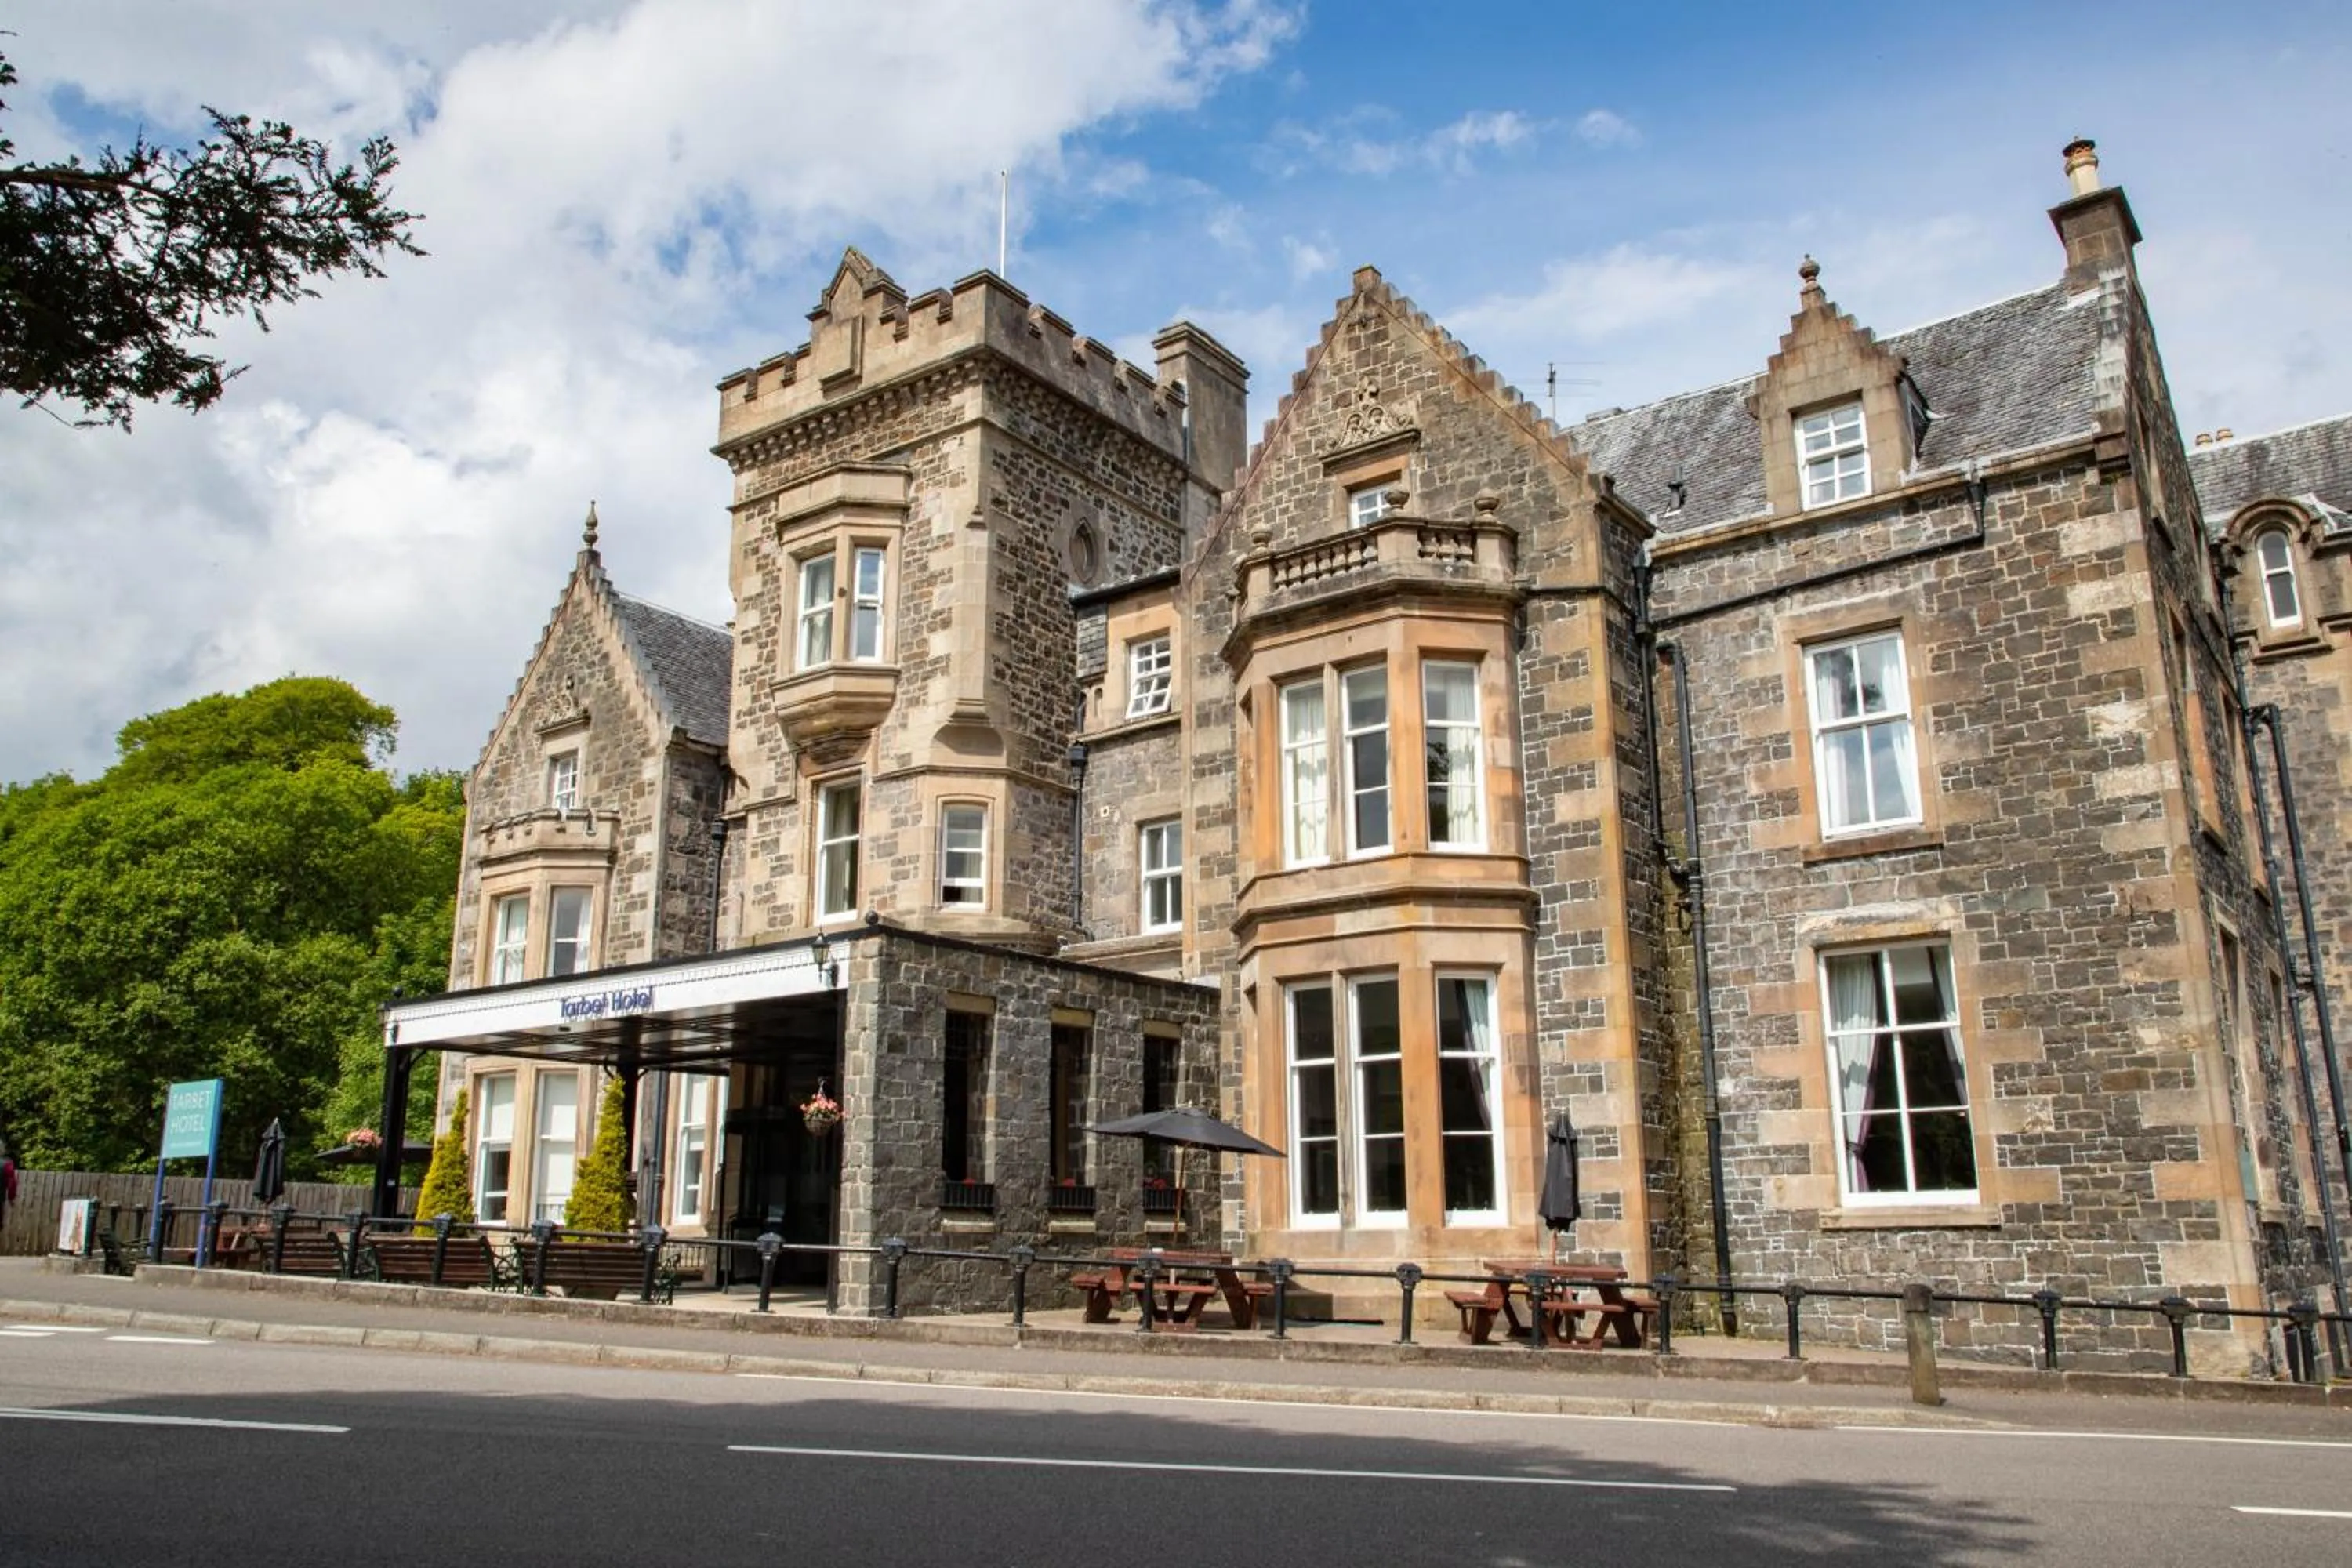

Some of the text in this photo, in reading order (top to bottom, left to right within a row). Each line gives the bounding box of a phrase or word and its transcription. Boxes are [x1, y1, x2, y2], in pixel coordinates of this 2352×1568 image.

[561, 985, 654, 1017] Tarbet Hotel
[172, 1091, 212, 1111] TARBET
[170, 1114, 205, 1134] HOTEL
